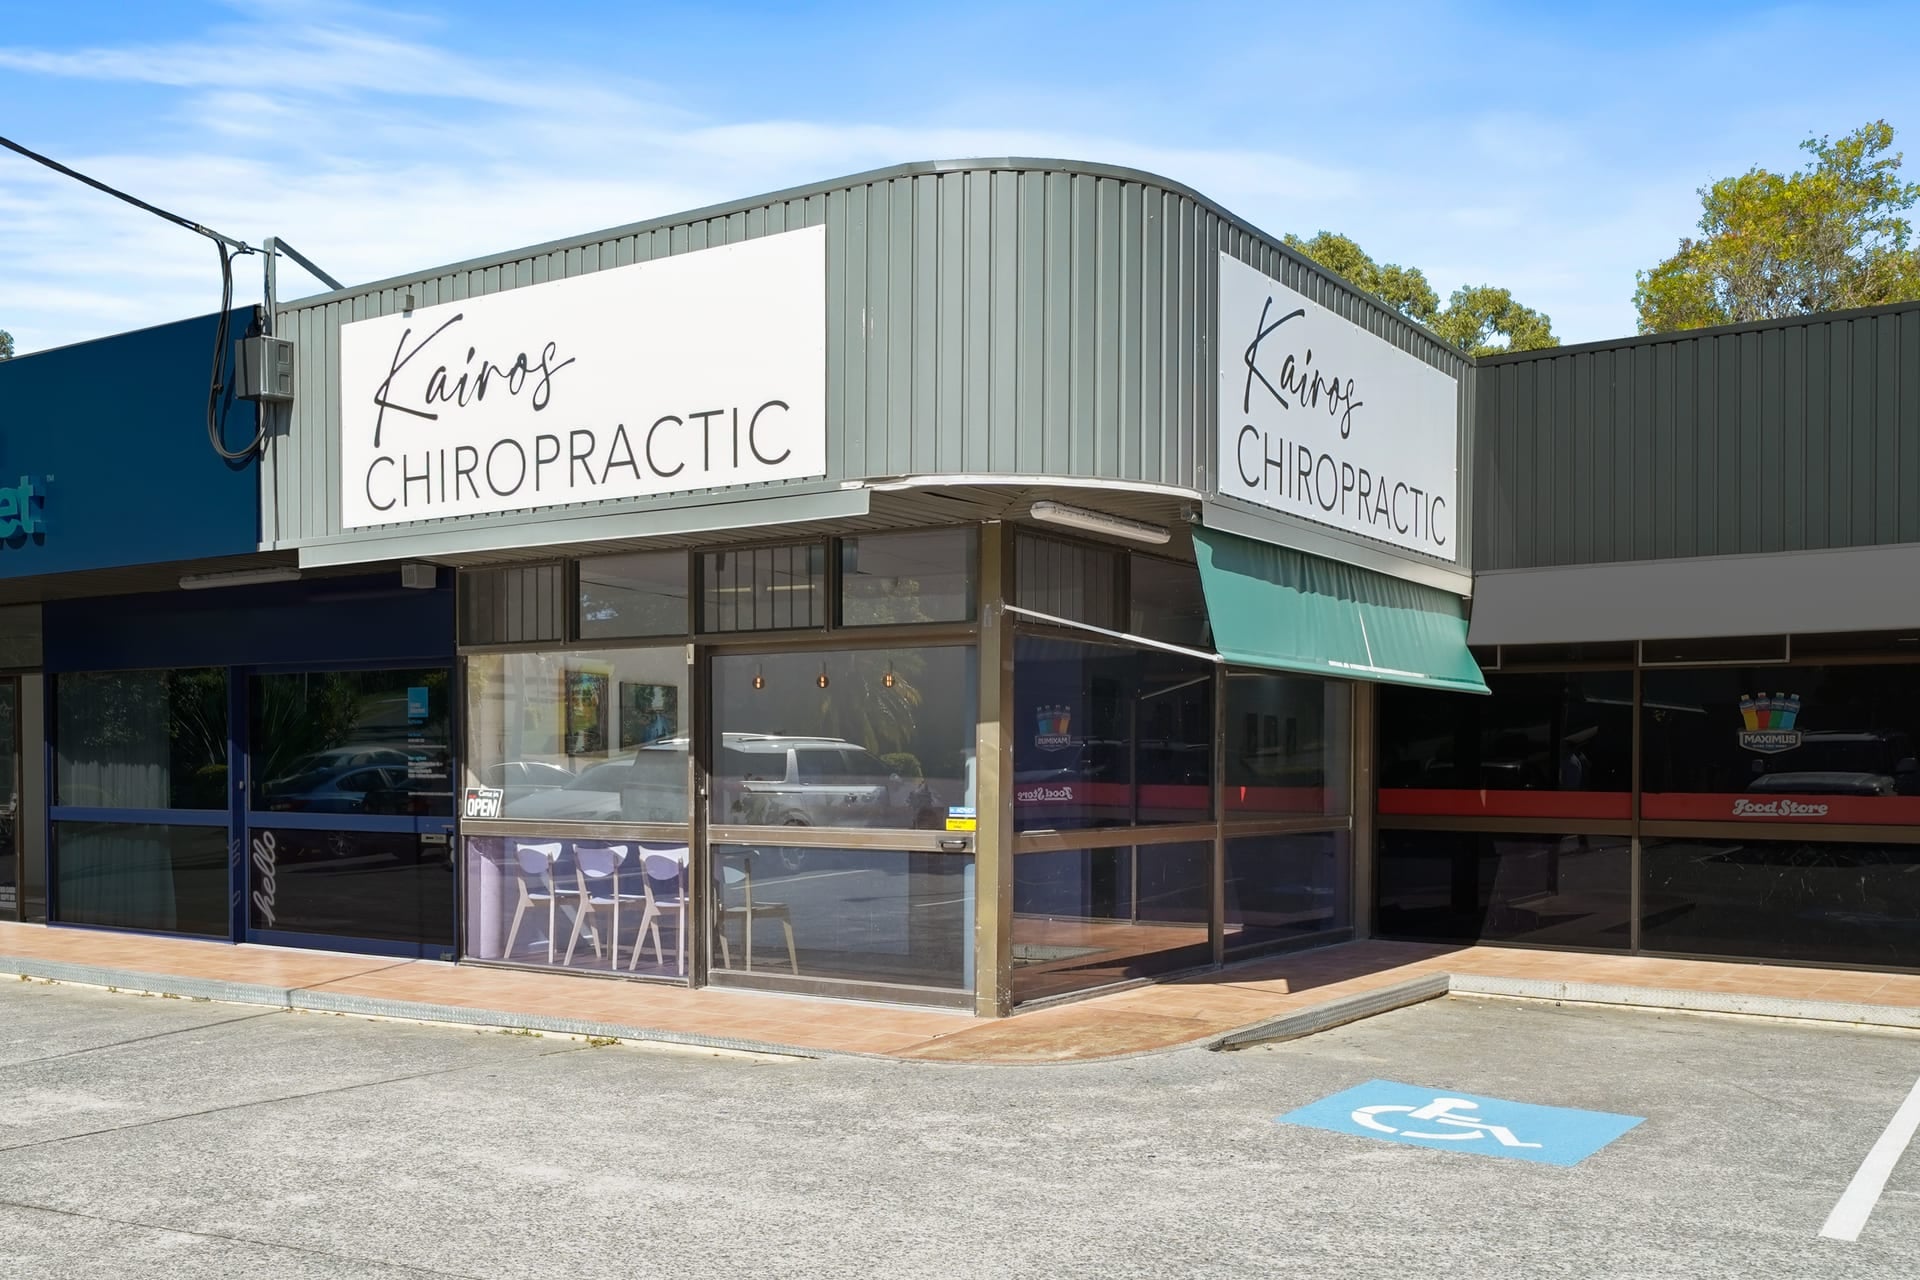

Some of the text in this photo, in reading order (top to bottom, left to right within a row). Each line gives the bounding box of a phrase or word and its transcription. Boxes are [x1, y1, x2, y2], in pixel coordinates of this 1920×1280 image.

[373, 312, 576, 449] Kairos
[1243, 295, 1364, 440] Kairos
[365, 399, 792, 512] CHIROPRACTIC
[1237, 424, 1447, 546] CHIROPRACTIC
[1744, 735, 1796, 744] MAXIMUS
[467, 797, 498, 817] OPEN
[1732, 799, 1829, 817] Food Store
[253, 831, 276, 928] hello
